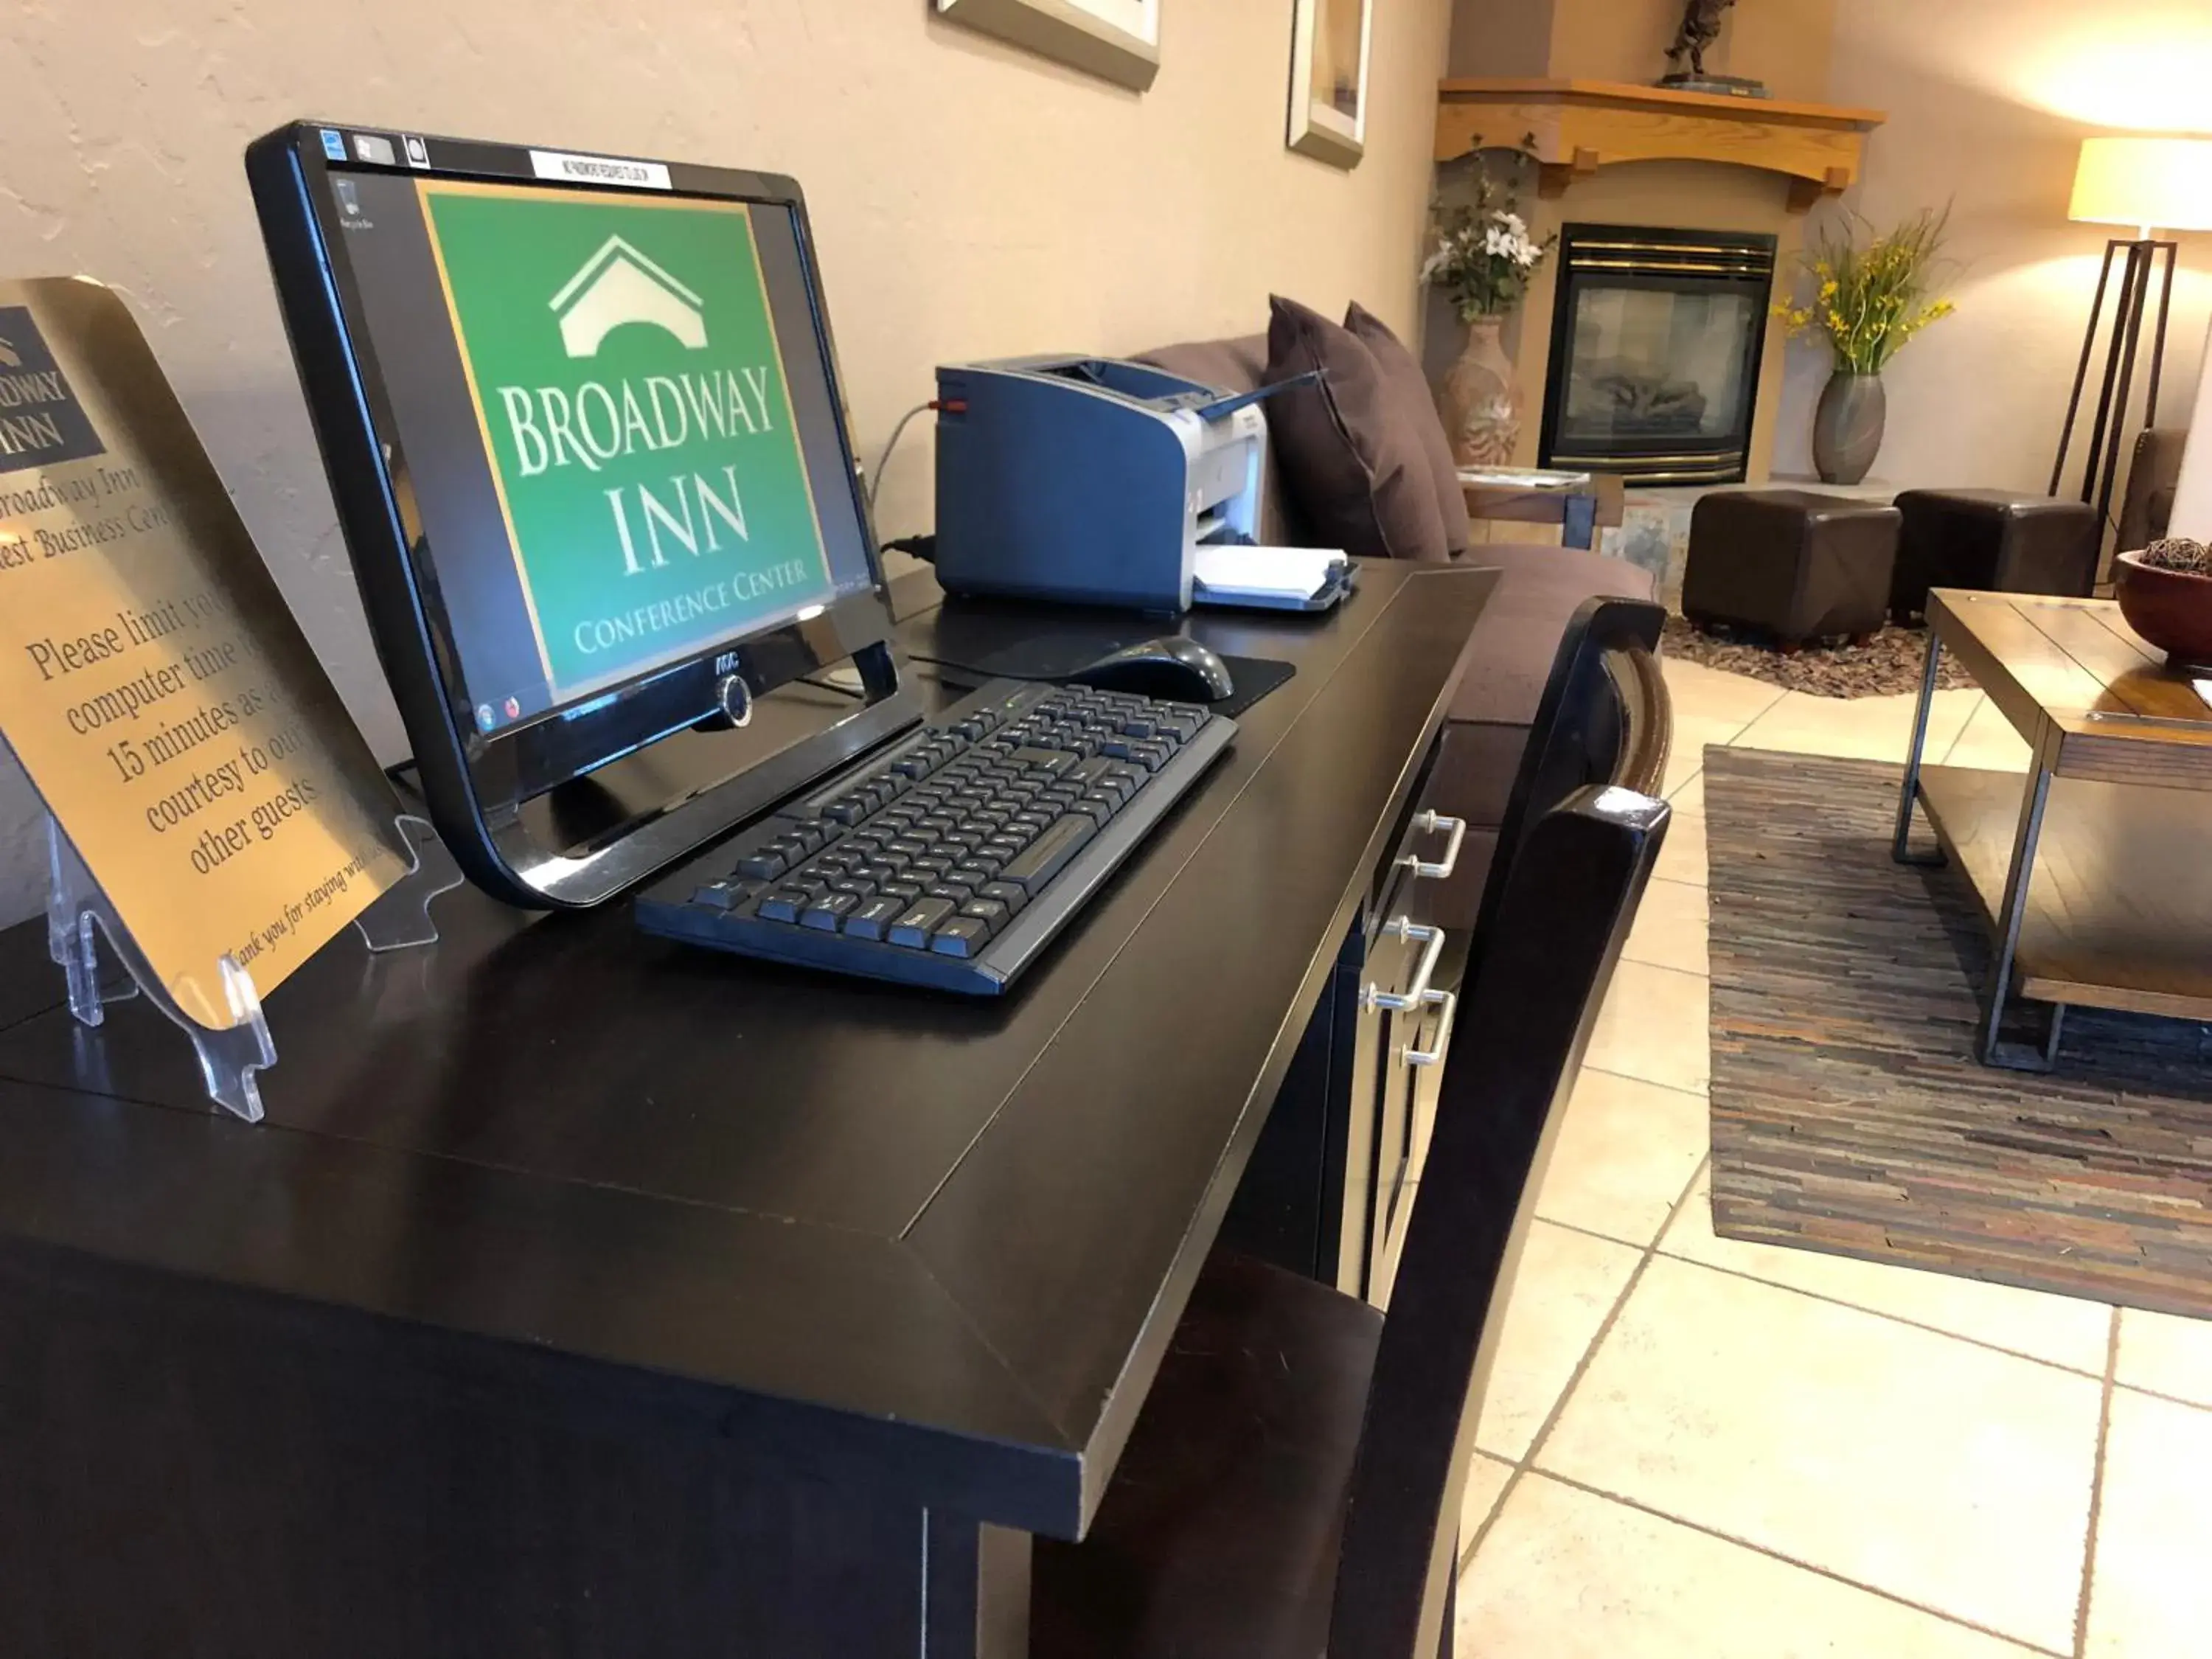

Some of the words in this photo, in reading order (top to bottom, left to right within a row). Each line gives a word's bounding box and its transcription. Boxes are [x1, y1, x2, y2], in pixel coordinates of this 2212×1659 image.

[0, 371, 66, 407] DWAY
[497, 366, 775, 476] BROADWAY
[0, 475, 100, 517] roadway
[97, 467, 139, 494] Inn
[603, 465, 749, 577] INN
[0, 535, 35, 570] est
[34, 516, 126, 558] Business
[26, 637, 124, 681] Please
[117, 598, 185, 647] limit
[574, 585, 730, 654] CONFERENCE
[732, 559, 808, 602] CENTER
[66, 665, 186, 735] computer
[181, 644, 236, 681] time
[106, 740, 145, 784] 15
[142, 705, 239, 767] minutes
[237, 686, 266, 717] as
[147, 771, 244, 833] courtesy
[240, 745, 268, 776] to
[190, 818, 253, 874] other
[251, 778, 320, 841] guests
[262, 919, 288, 953] you
[284, 903, 305, 936] for
[304, 870, 349, 913] staying
